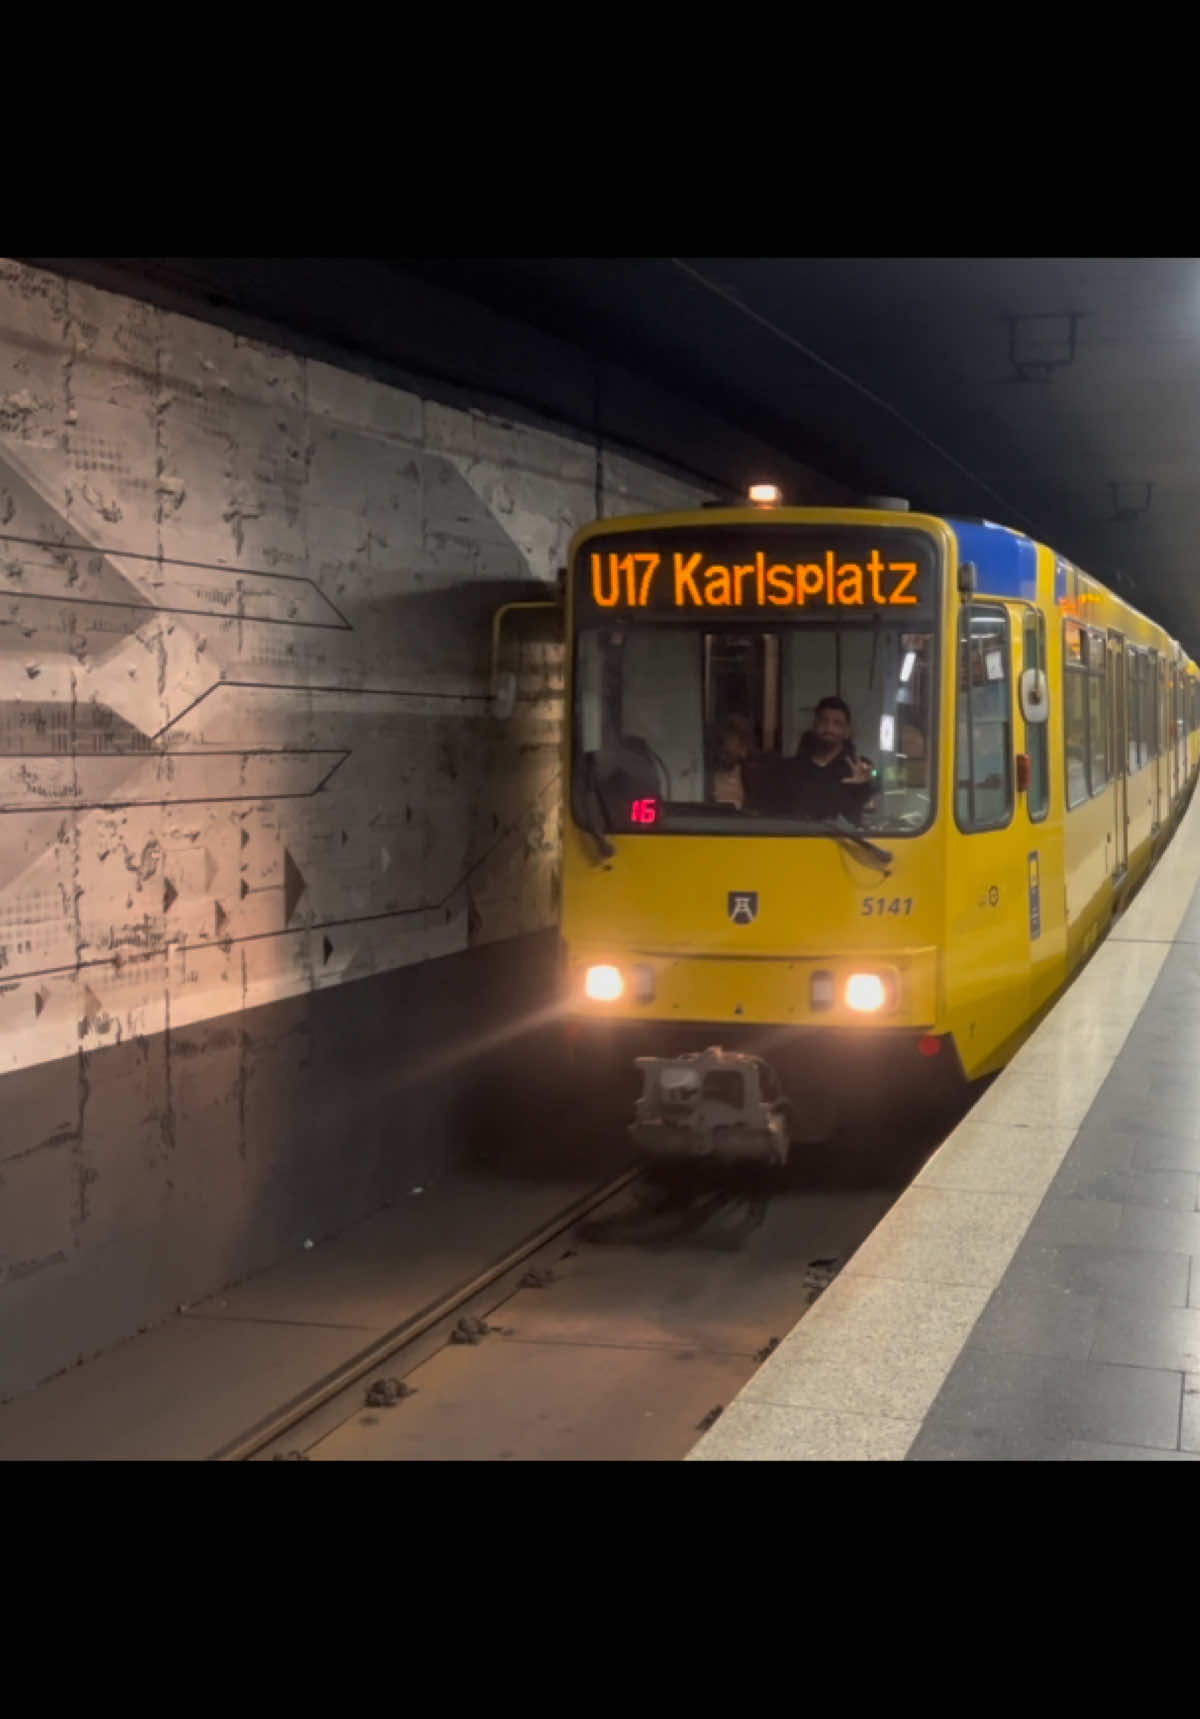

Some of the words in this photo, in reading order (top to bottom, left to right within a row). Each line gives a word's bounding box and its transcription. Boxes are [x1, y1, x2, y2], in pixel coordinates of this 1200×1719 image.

[591, 552, 660, 607] U17
[674, 550, 918, 607] Karlsplatz
[860, 896, 914, 917] 5141
